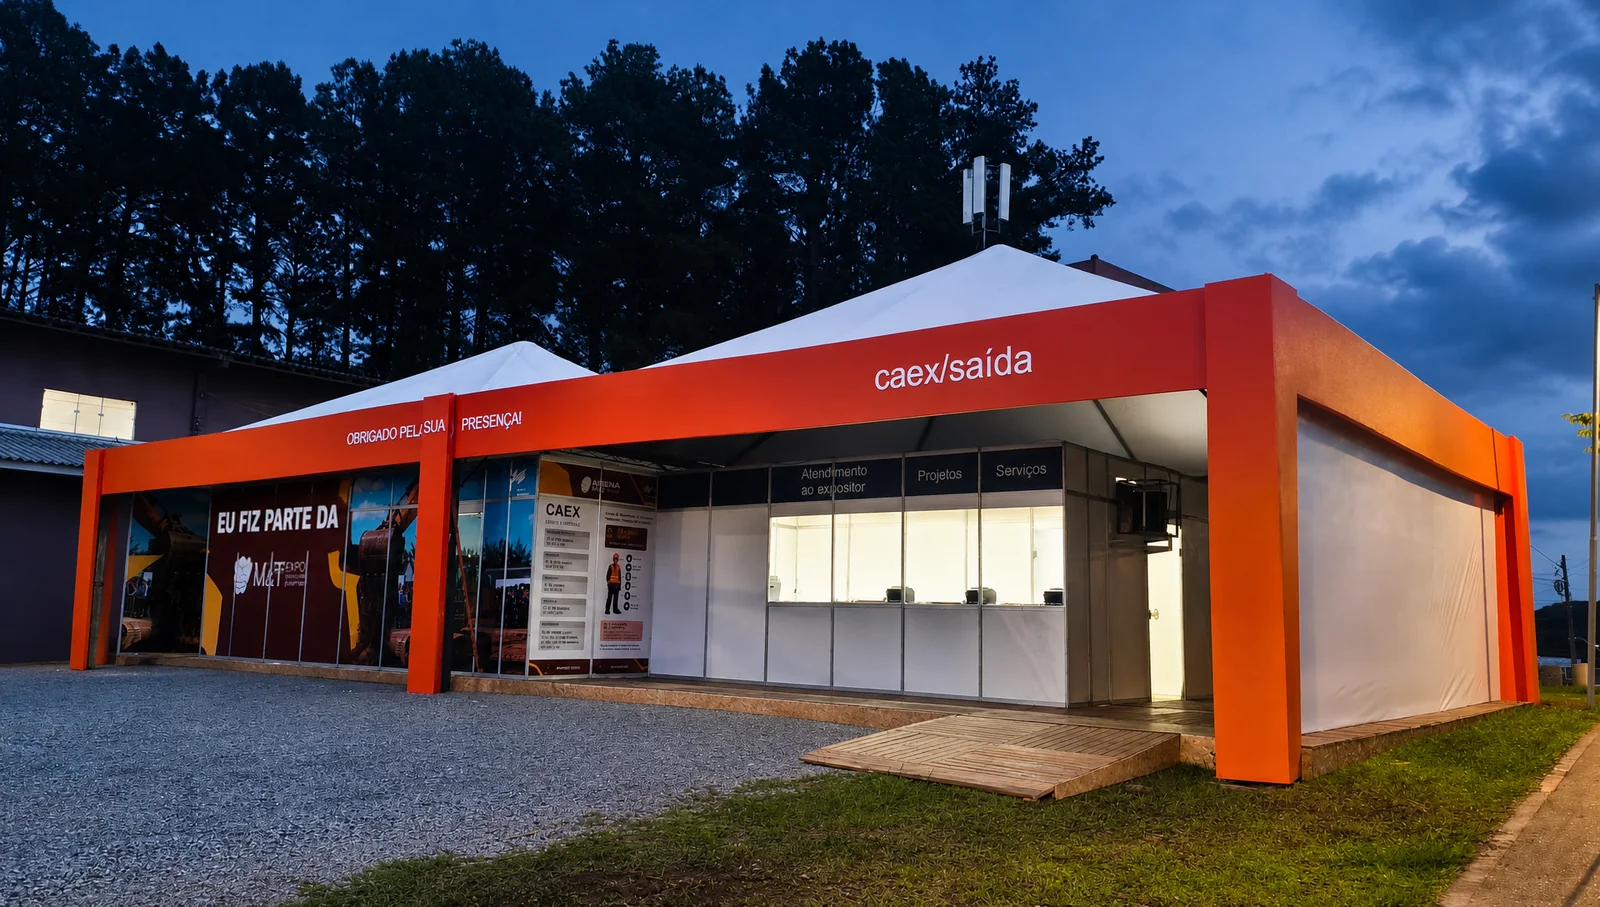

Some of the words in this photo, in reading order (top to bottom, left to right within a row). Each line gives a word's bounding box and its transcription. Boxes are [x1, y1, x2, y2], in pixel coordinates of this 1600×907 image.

[874, 345, 1033, 391] caex/saída
[346, 427, 398, 445] OBRIGADO
[423, 418, 446, 434] SUA
[461, 411, 522, 431] PRESENÇA!
[917, 468, 963, 484] Projetos
[996, 464, 1047, 479] Serviços
[801, 486, 814, 496] ao
[817, 482, 866, 498] expositor
[217, 511, 236, 534] EU
[238, 510, 261, 533] FIZ
[264, 506, 313, 532] PARTE
[316, 504, 339, 530] DA
[545, 503, 581, 519] CAEX
